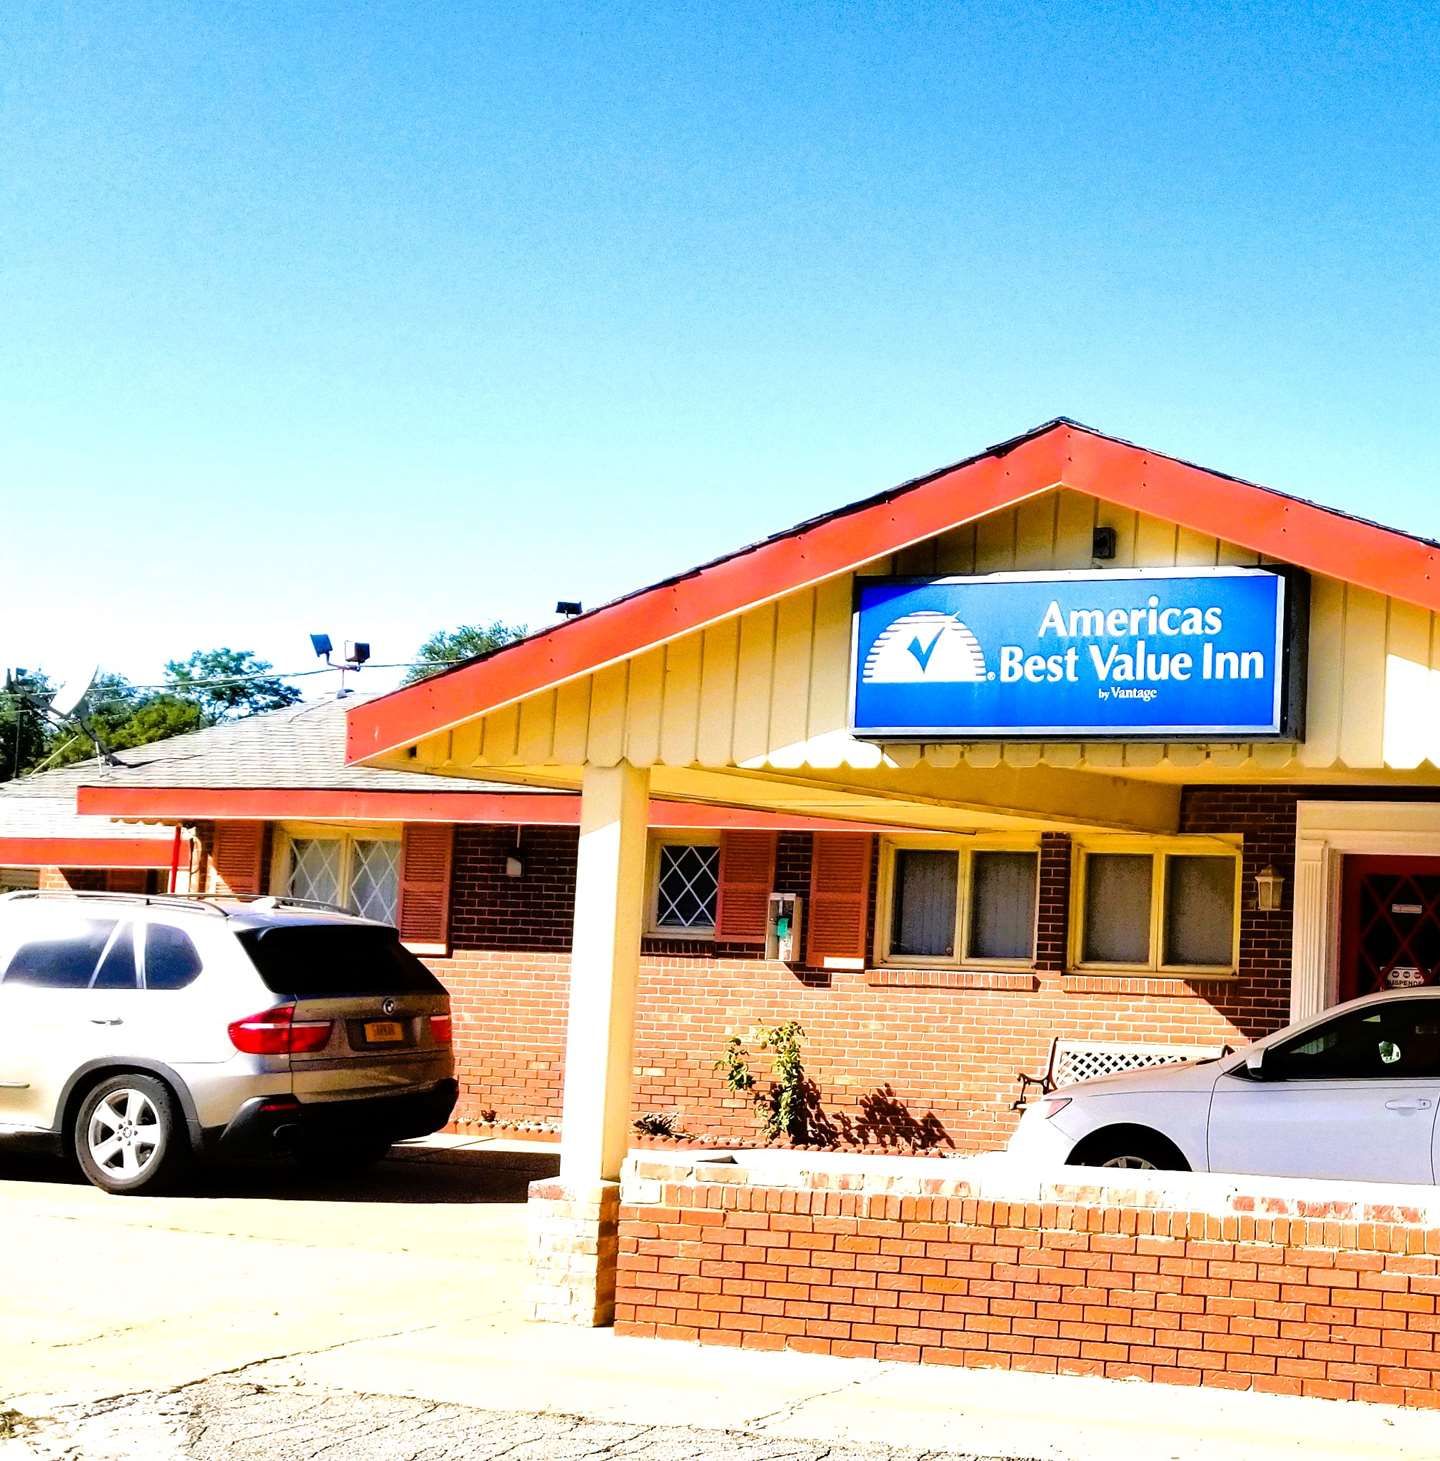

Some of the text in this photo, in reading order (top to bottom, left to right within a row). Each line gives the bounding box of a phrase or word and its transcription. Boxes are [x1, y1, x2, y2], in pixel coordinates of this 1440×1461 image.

[1038, 595, 1223, 638] Americas
[1000, 641, 1264, 683] Best Value Inn
[1098, 687, 1158, 702] by Vantage
